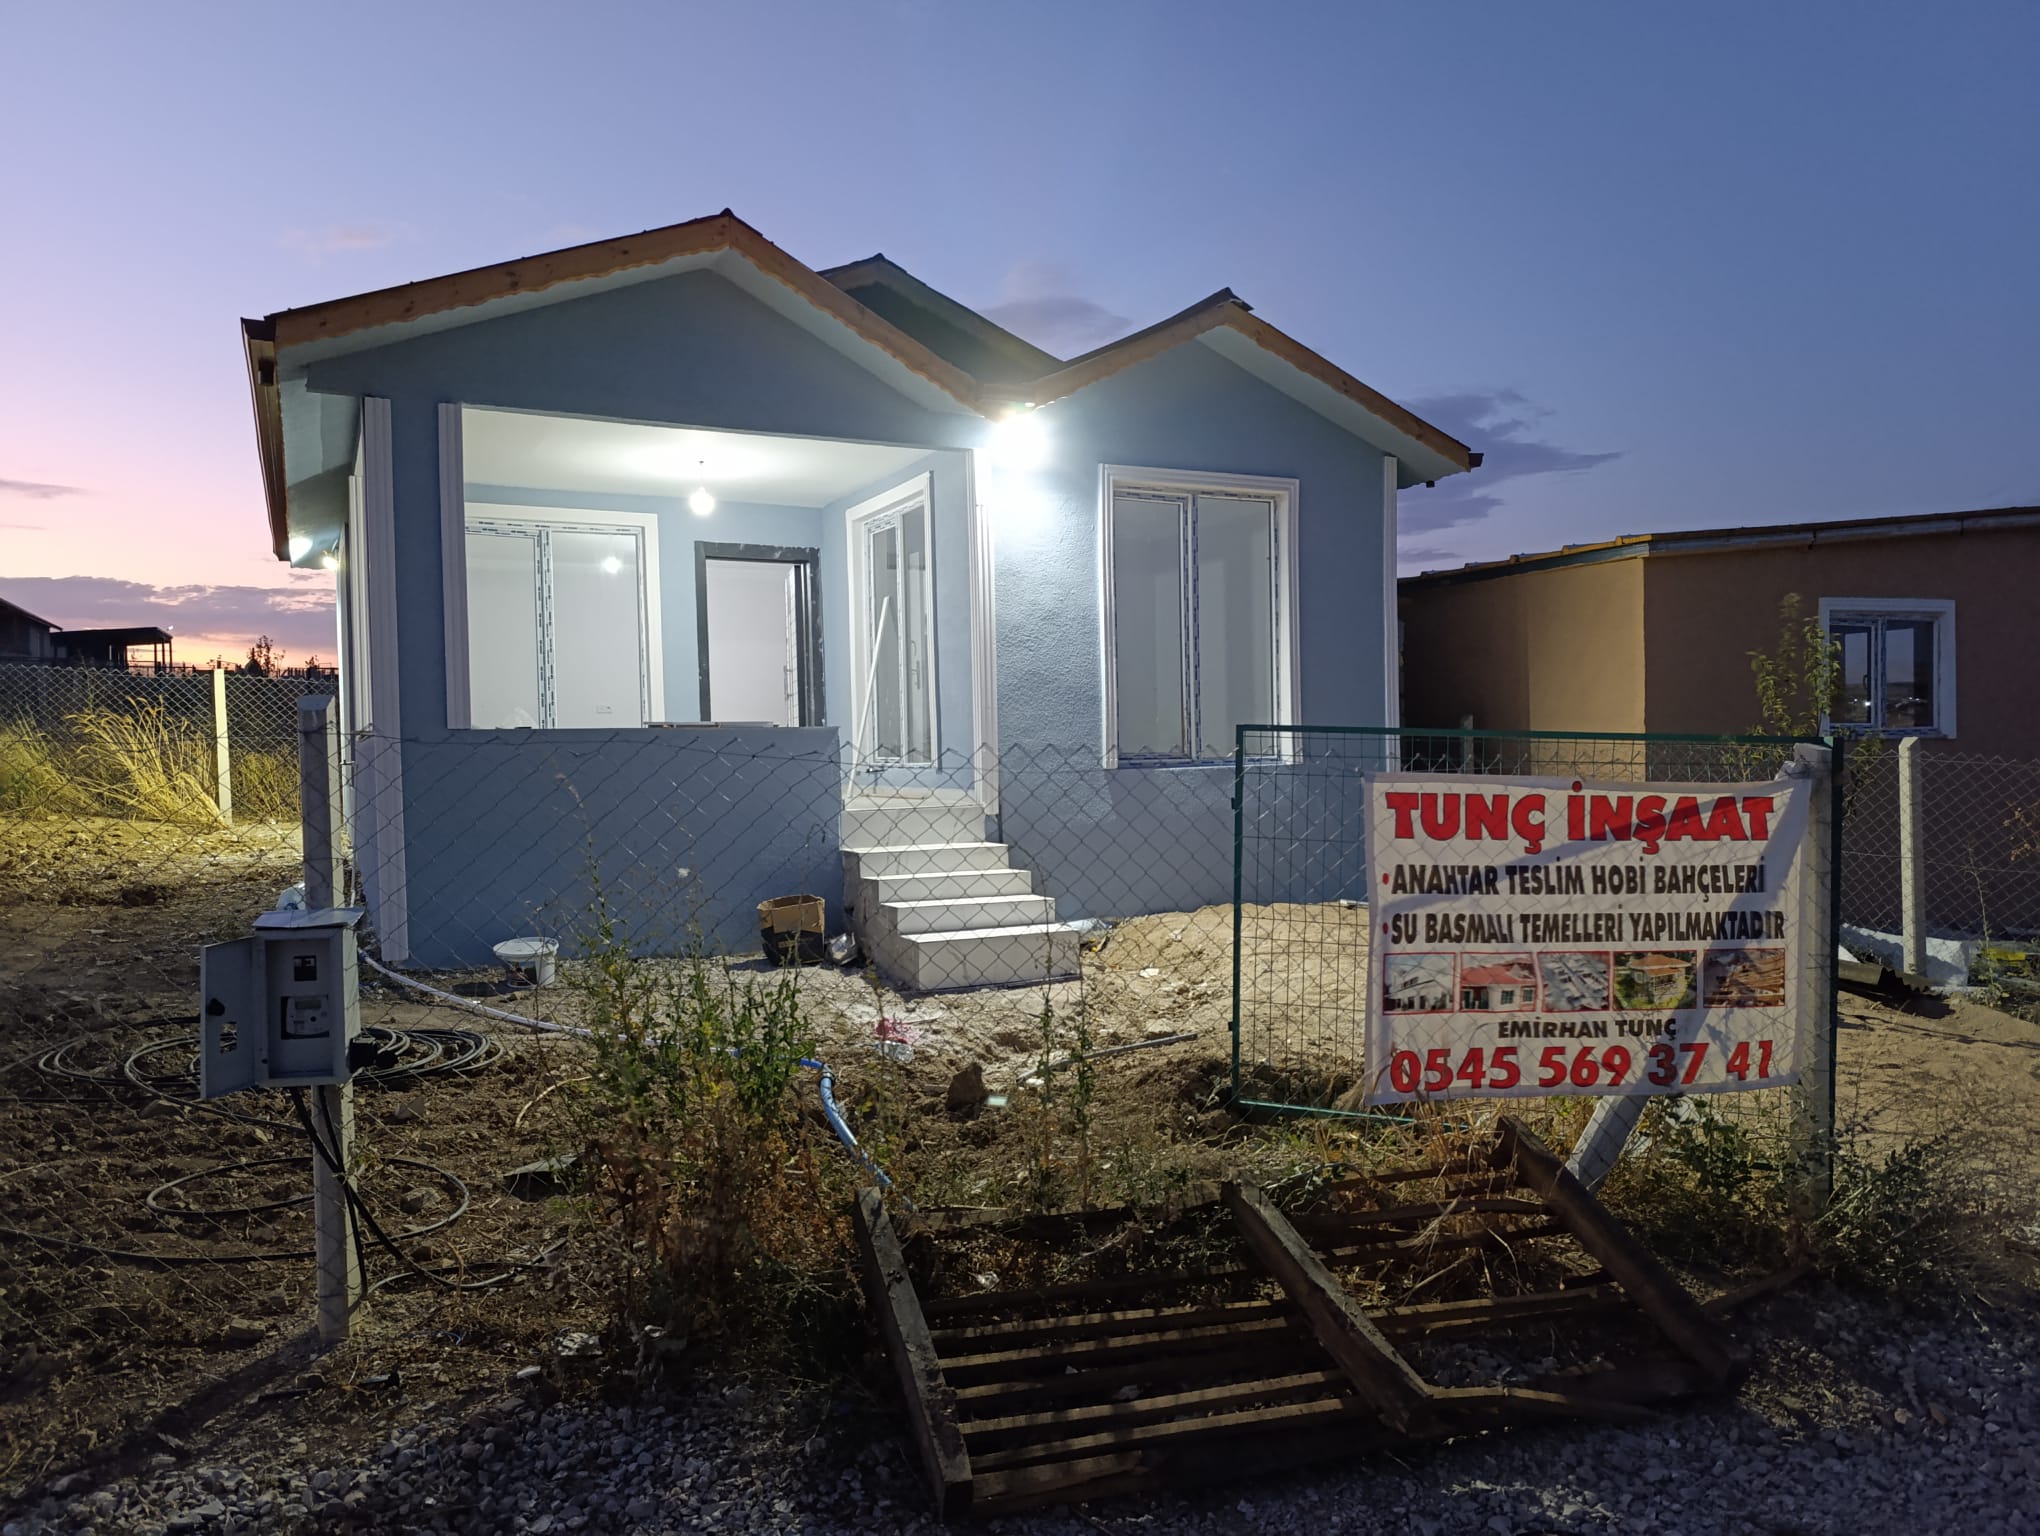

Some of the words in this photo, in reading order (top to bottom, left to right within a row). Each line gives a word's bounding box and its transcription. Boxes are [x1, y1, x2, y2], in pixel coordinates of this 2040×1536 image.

[1385, 792, 1545, 854] TUNÇ
[1567, 781, 1774, 855] İNŞAAT
[1391, 864, 1499, 895] ANAHTAR
[1505, 856, 1585, 895] TESLİM
[1591, 856, 1646, 895] HOBİ
[1654, 855, 1765, 903] BAHÇELERİ
[1391, 913, 1417, 944] SU
[1425, 913, 1514, 944] BASMALI
[1520, 904, 1623, 943] TEMELLERİ
[1629, 910, 1785, 941] YAPILMAKTADIR
[1498, 1016, 1608, 1039] EMİRHAN
[1615, 1018, 1677, 1041] TUNÇ
[1390, 1046, 1521, 1093] 0545
[1538, 1045, 1632, 1088] 569
[1648, 1043, 1710, 1087] 37
[1726, 1040, 1773, 1081] 41
